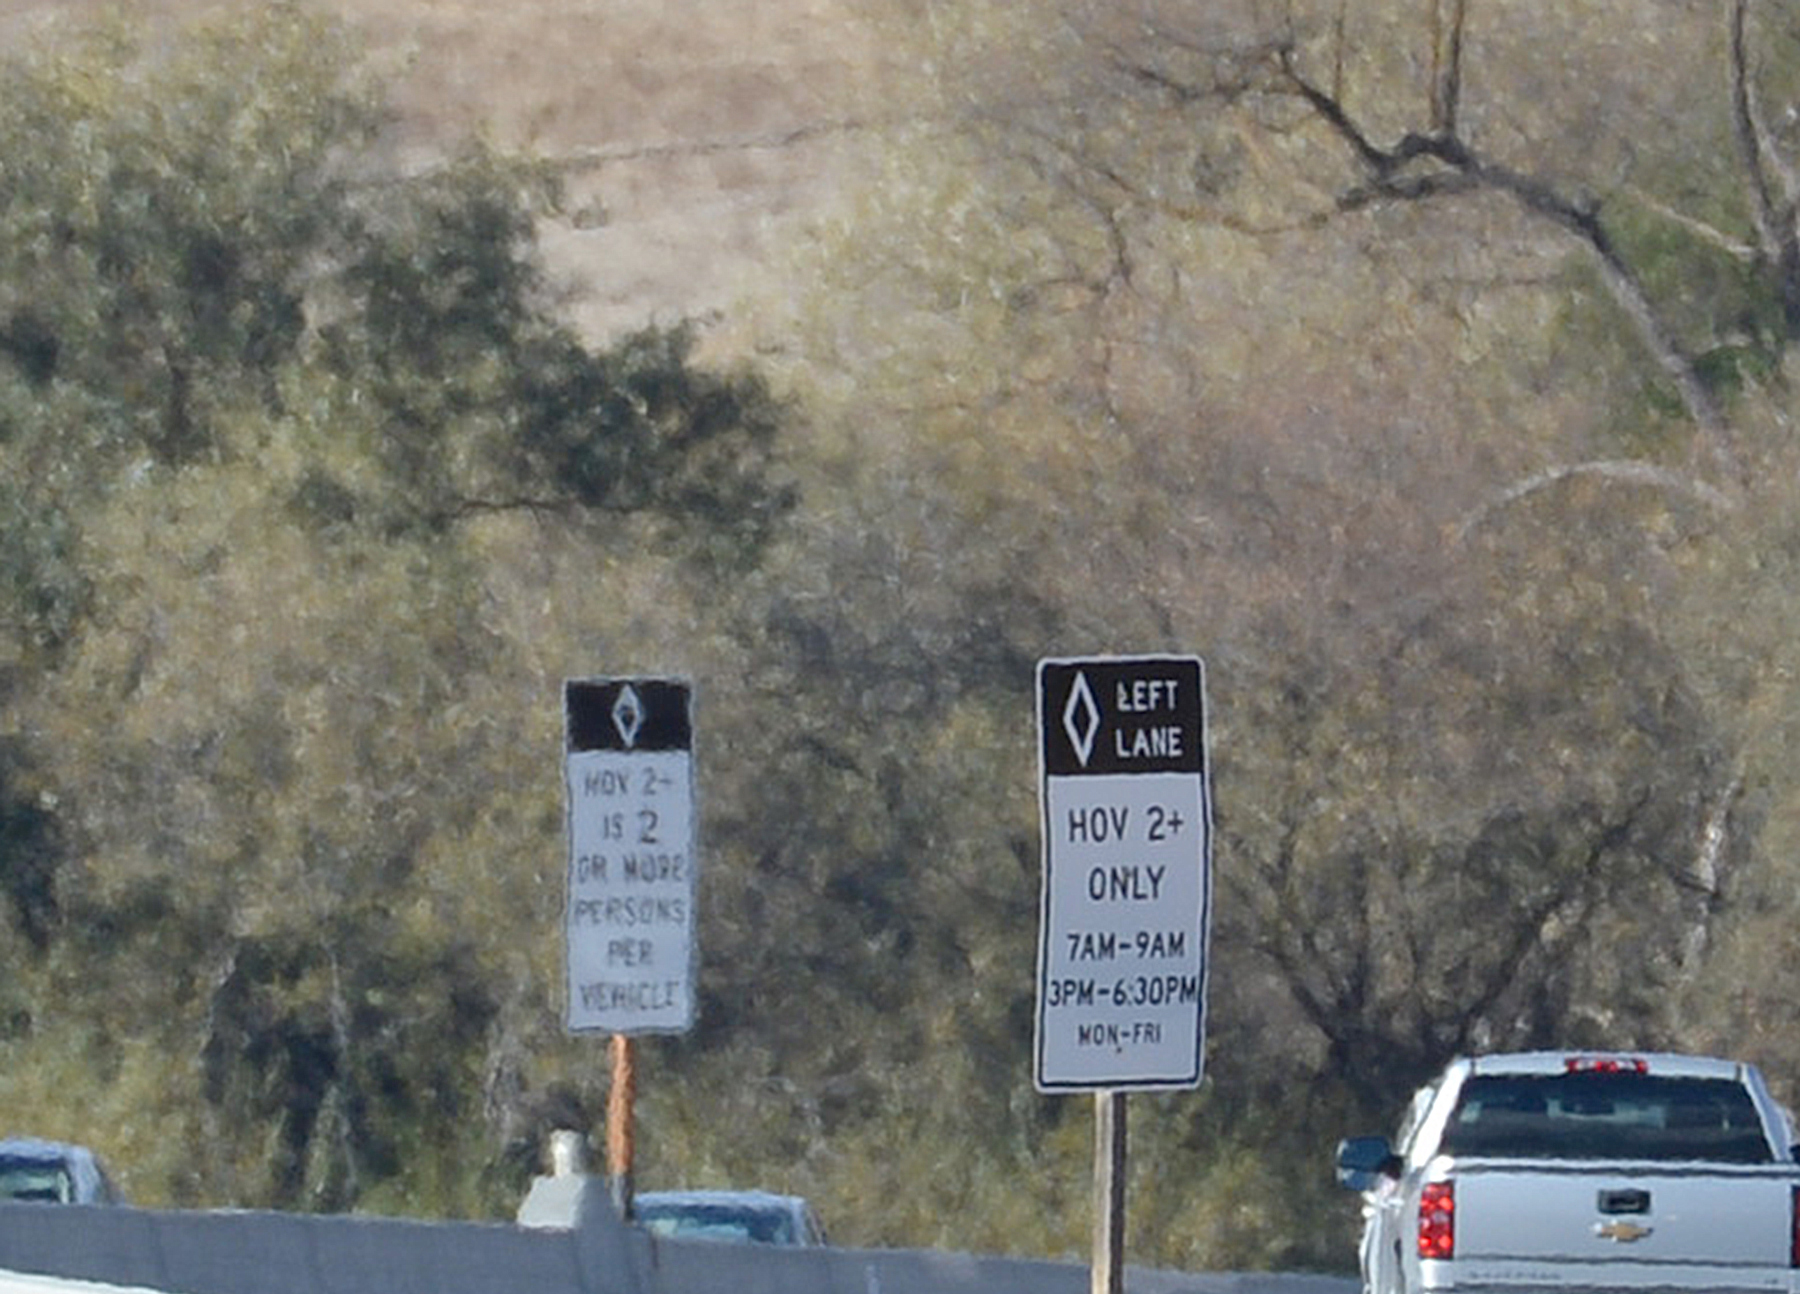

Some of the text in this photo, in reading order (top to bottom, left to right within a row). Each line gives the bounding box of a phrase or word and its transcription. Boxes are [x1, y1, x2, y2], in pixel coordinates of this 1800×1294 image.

[1116, 680, 1179, 712] LEFT
[1115, 726, 1184, 759] LANE
[583, 769, 628, 797] HOV
[602, 809, 659, 845] IS 2
[1068, 805, 1185, 843] HOV 2+
[577, 855, 608, 884] OR
[1088, 865, 1166, 901] ONLY
[575, 896, 686, 926] PERSONS
[607, 936, 654, 968] PER
[1066, 931, 1185, 961] 7AM-9AM
[579, 981, 679, 1012] VEHICLE
[1048, 975, 1197, 1007] 3PM-6:30PM
[1076, 1022, 1162, 1046] MON-FRI
